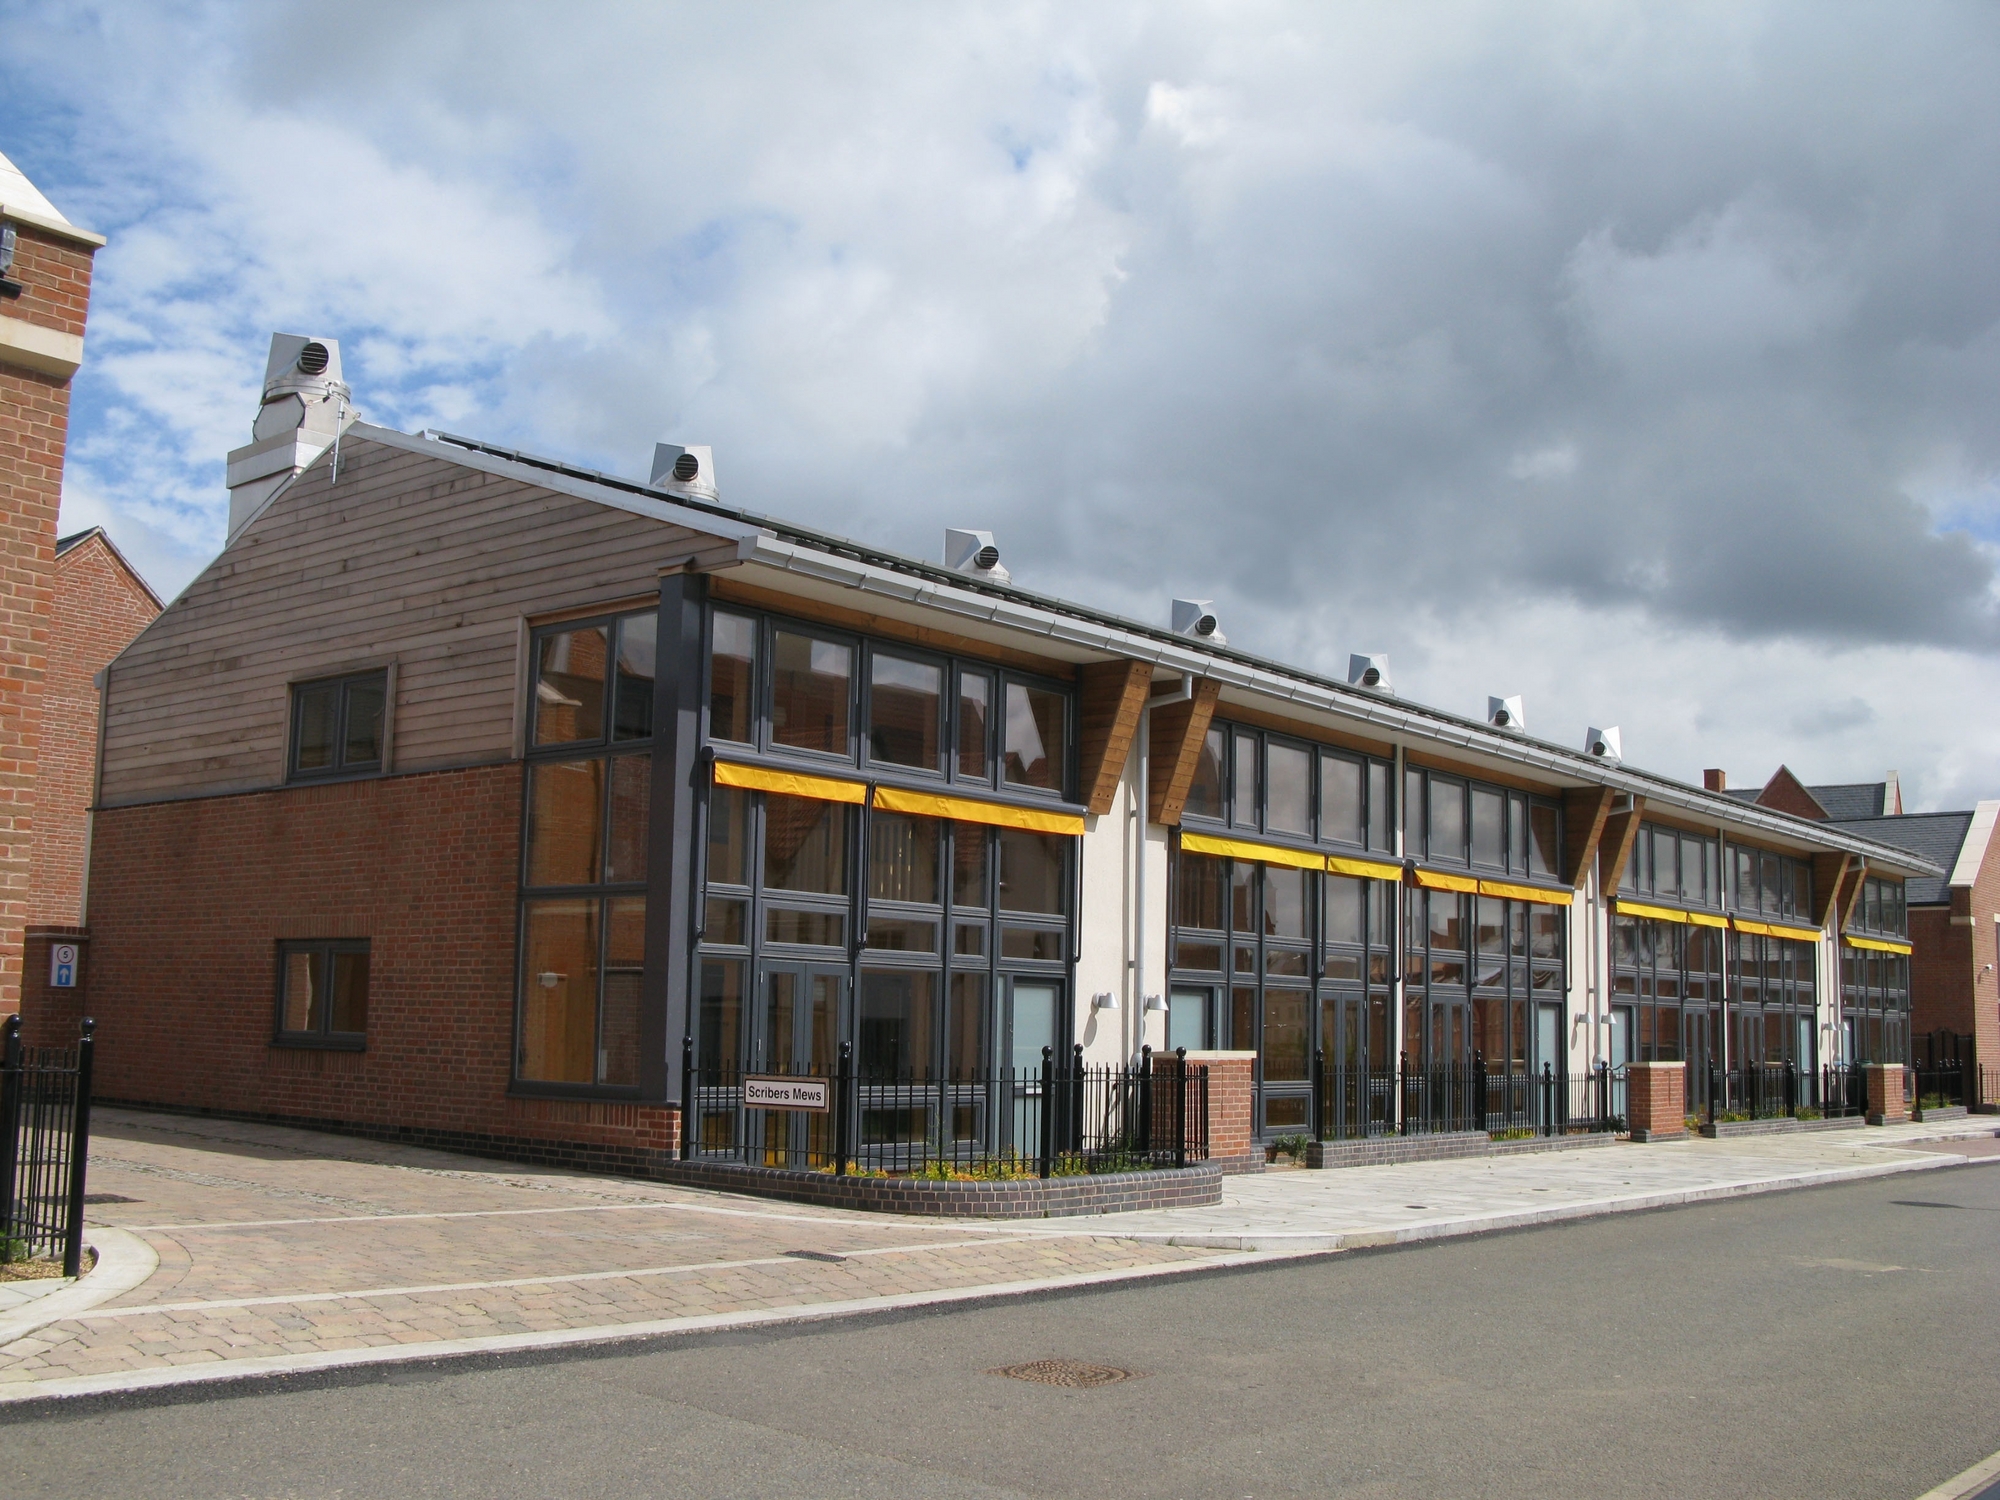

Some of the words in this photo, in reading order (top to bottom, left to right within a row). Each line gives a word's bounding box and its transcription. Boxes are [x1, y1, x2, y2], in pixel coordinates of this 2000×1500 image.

[63, 950, 69, 959] 5
[748, 1085, 790, 1099] Scribers
[793, 1087, 821, 1101] Mews
